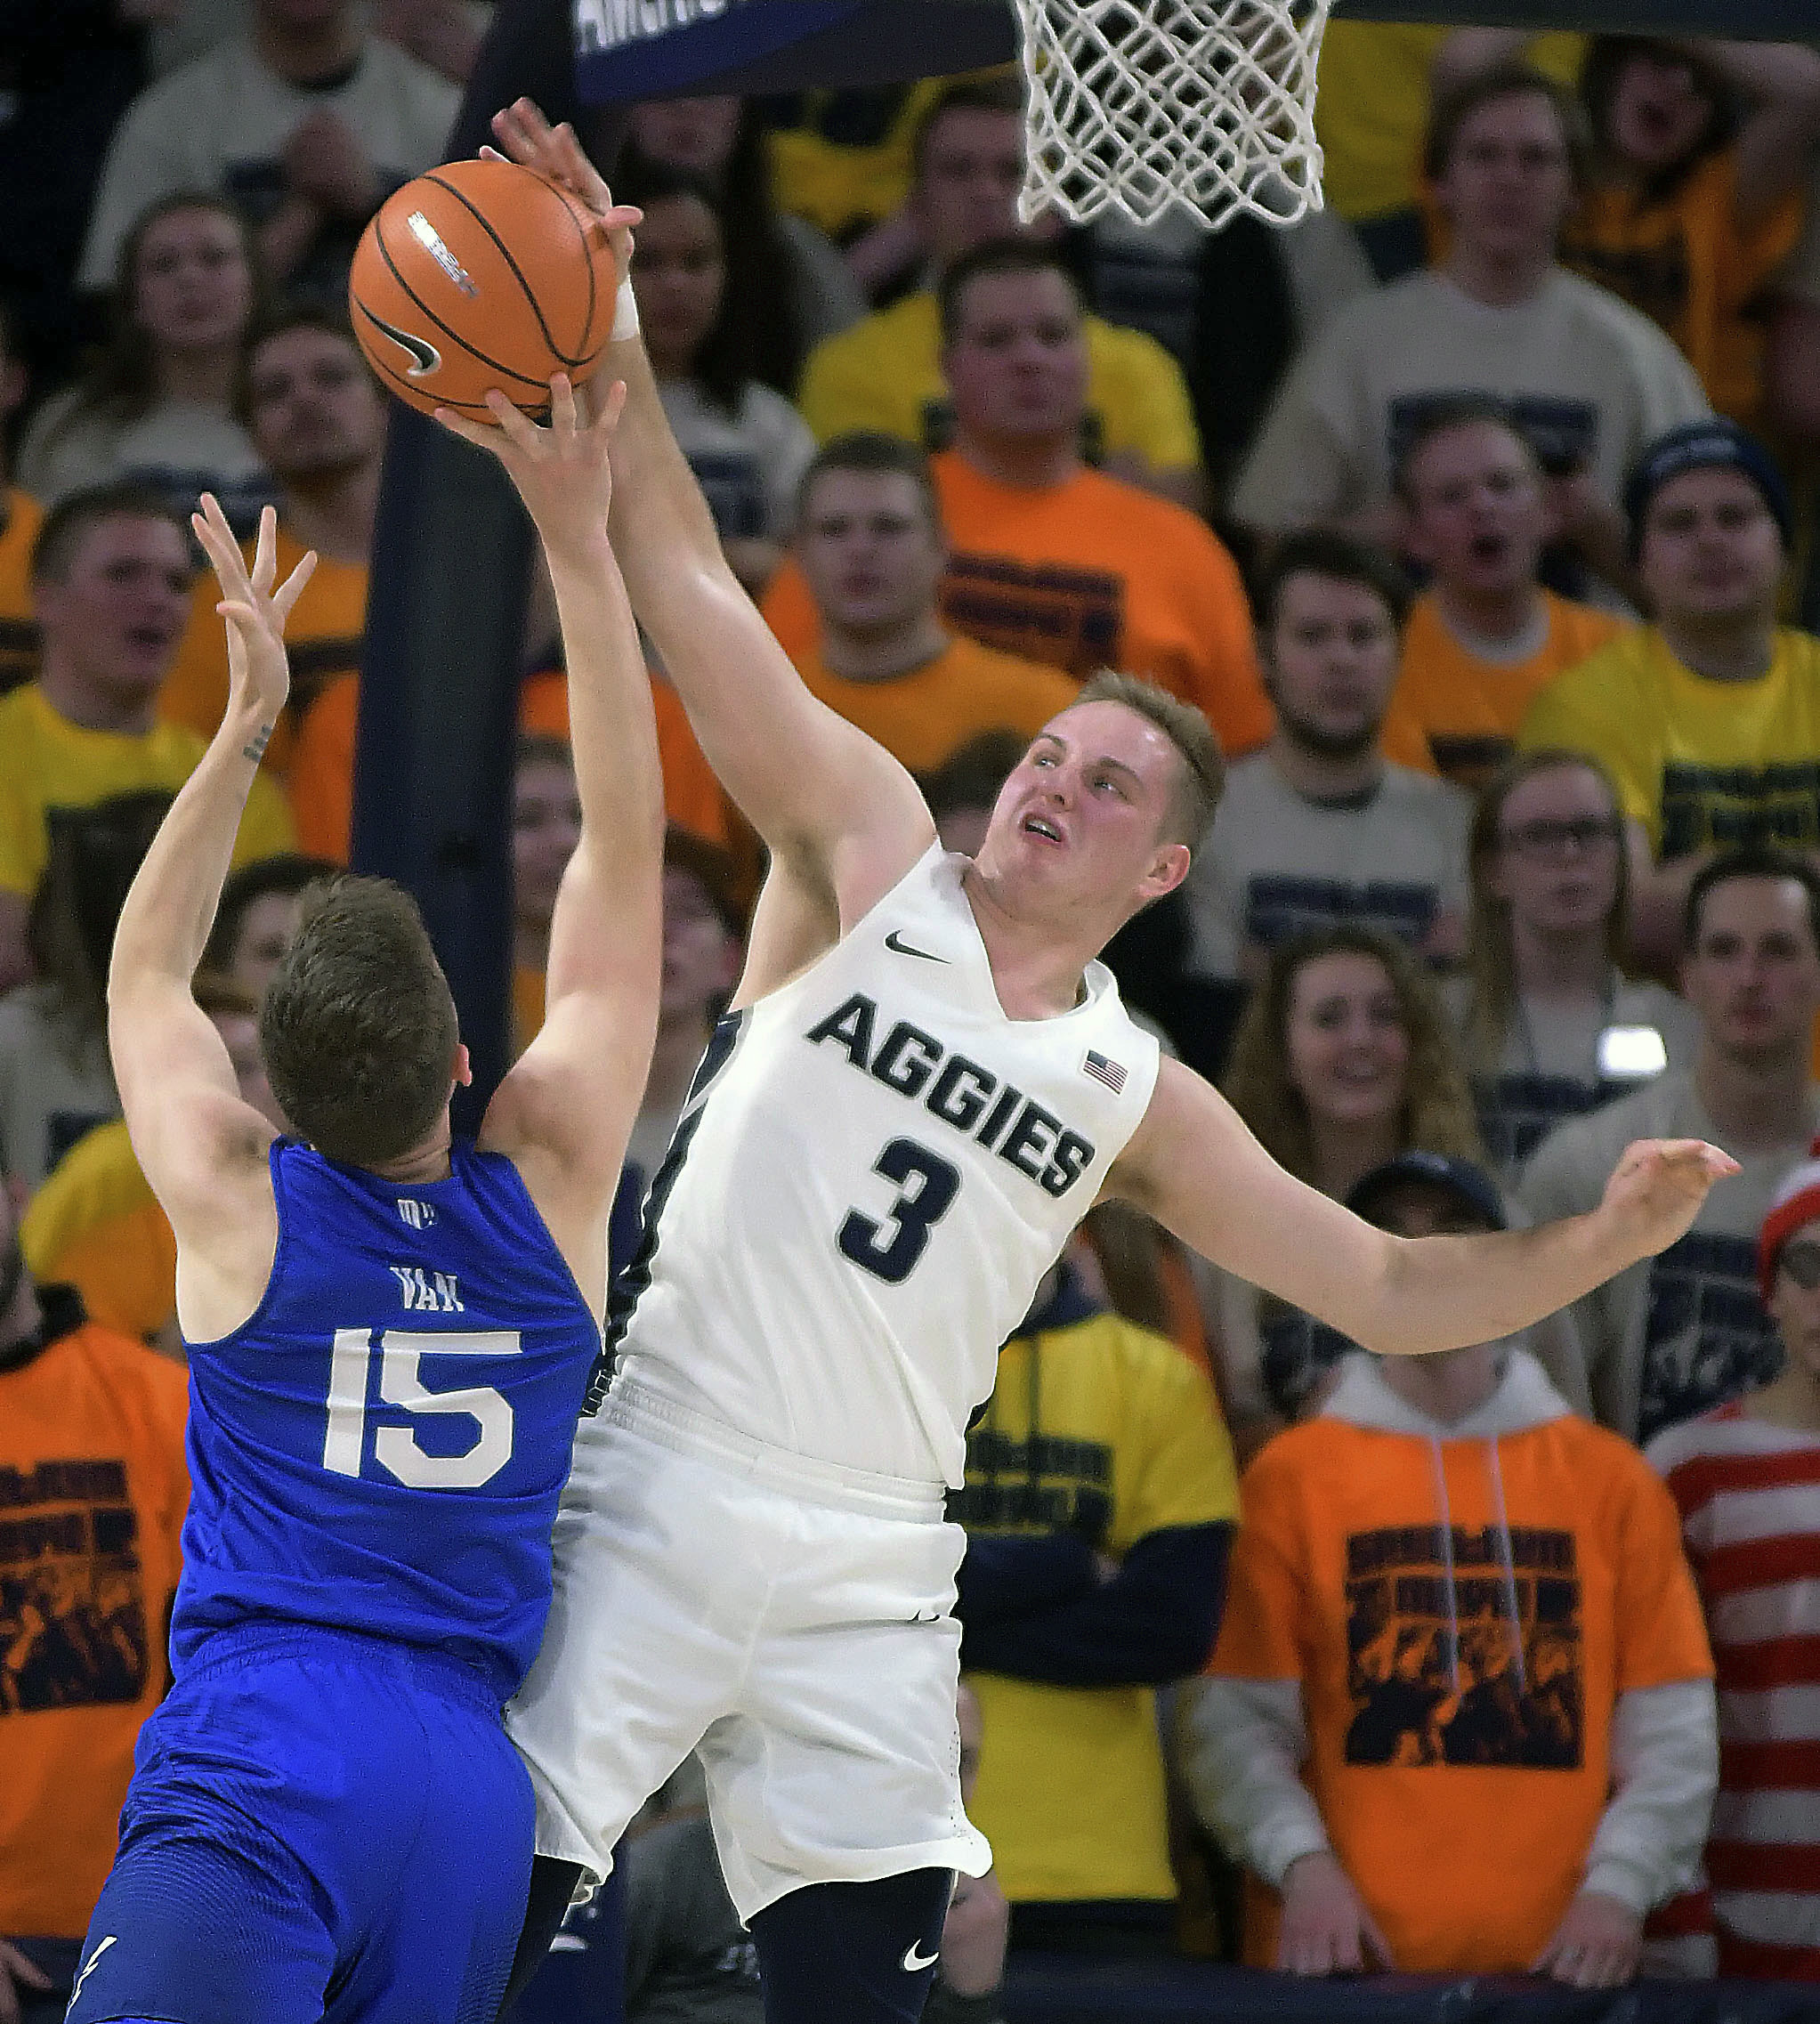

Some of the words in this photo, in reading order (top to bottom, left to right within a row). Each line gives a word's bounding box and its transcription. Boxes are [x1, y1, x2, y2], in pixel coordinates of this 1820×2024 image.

[804, 992, 1096, 1198] AGGIES
[835, 1136, 964, 1286] 3
[390, 1266, 465, 1312] VAN
[323, 1327, 523, 1488] 15
